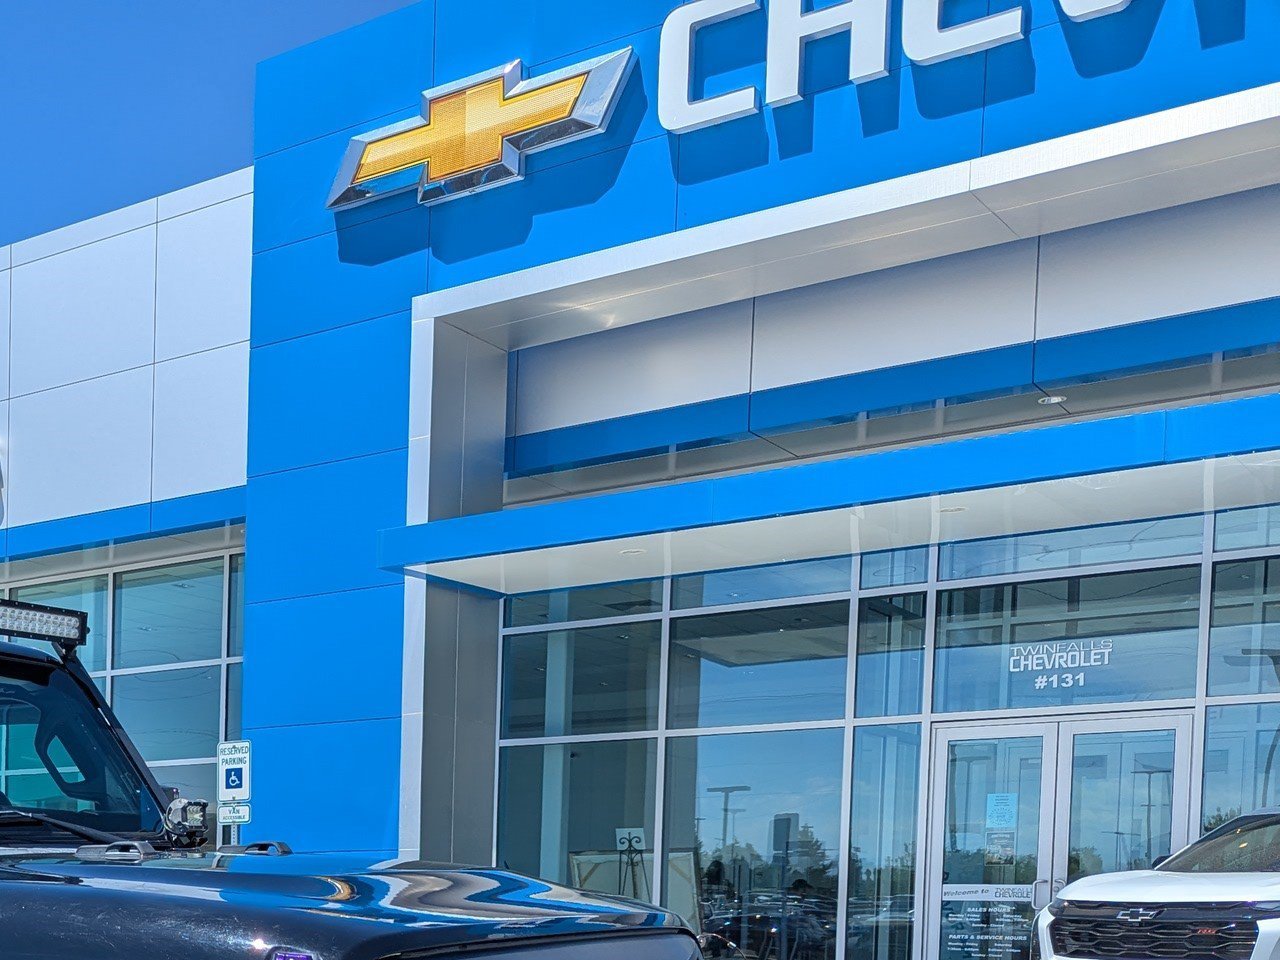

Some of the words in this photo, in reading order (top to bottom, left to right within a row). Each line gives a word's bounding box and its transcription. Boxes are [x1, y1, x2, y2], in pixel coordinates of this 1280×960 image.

[1010, 639, 1113, 656] TWINFALLS
[1010, 648, 1112, 672] CHEVROLET
[1034, 672, 1085, 690] #131
[220, 746, 249, 756] RESERVED
[221, 757, 247, 766] PARKING
